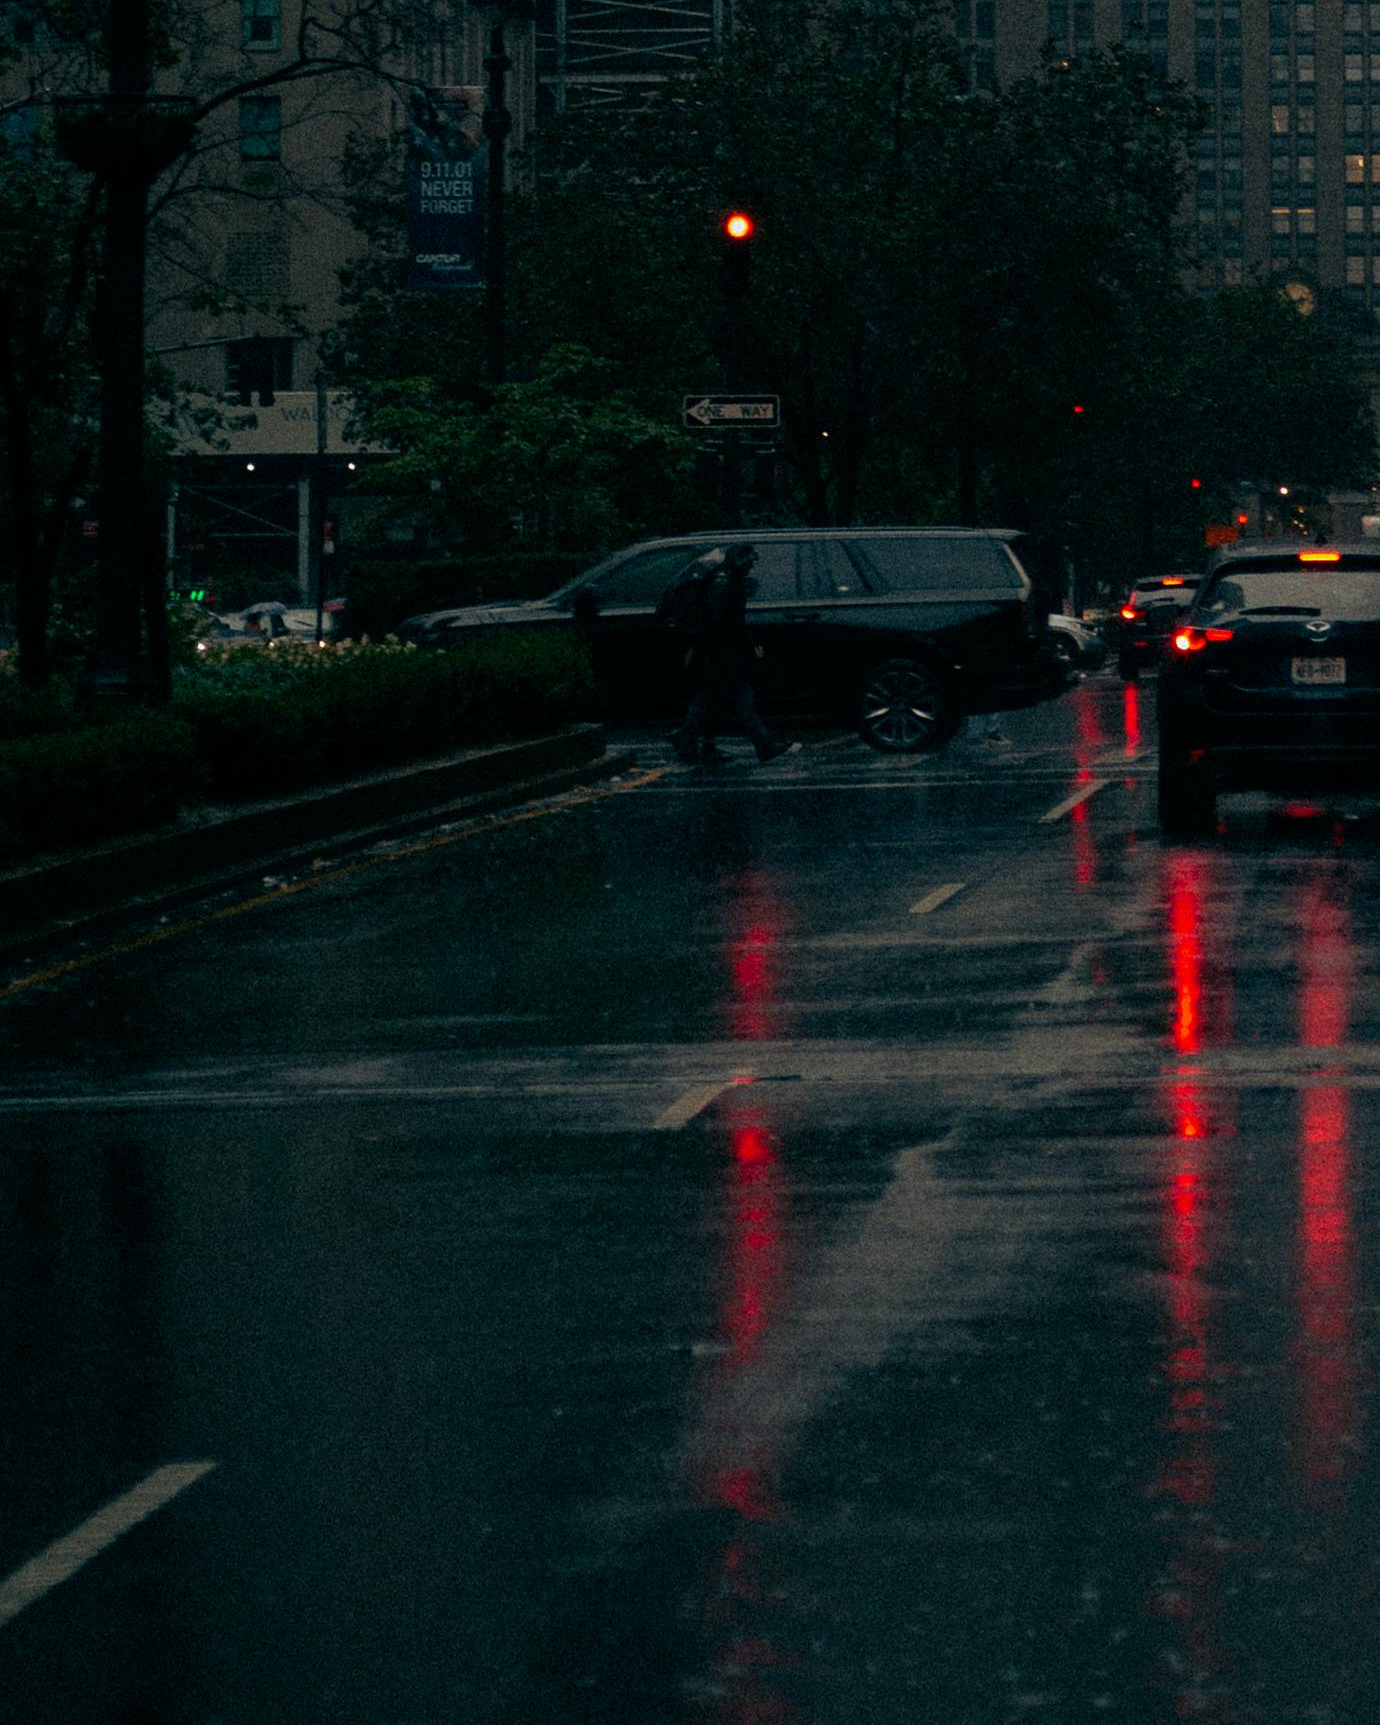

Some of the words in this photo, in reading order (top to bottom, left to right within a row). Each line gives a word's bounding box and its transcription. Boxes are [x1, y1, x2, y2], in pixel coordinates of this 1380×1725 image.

[420, 161, 473, 179] 9.11.01
[420, 180, 473, 197] NEVER
[420, 199, 475, 214] FORGET
[696, 405, 725, 418] ONE
[740, 405, 769, 418] WAY
